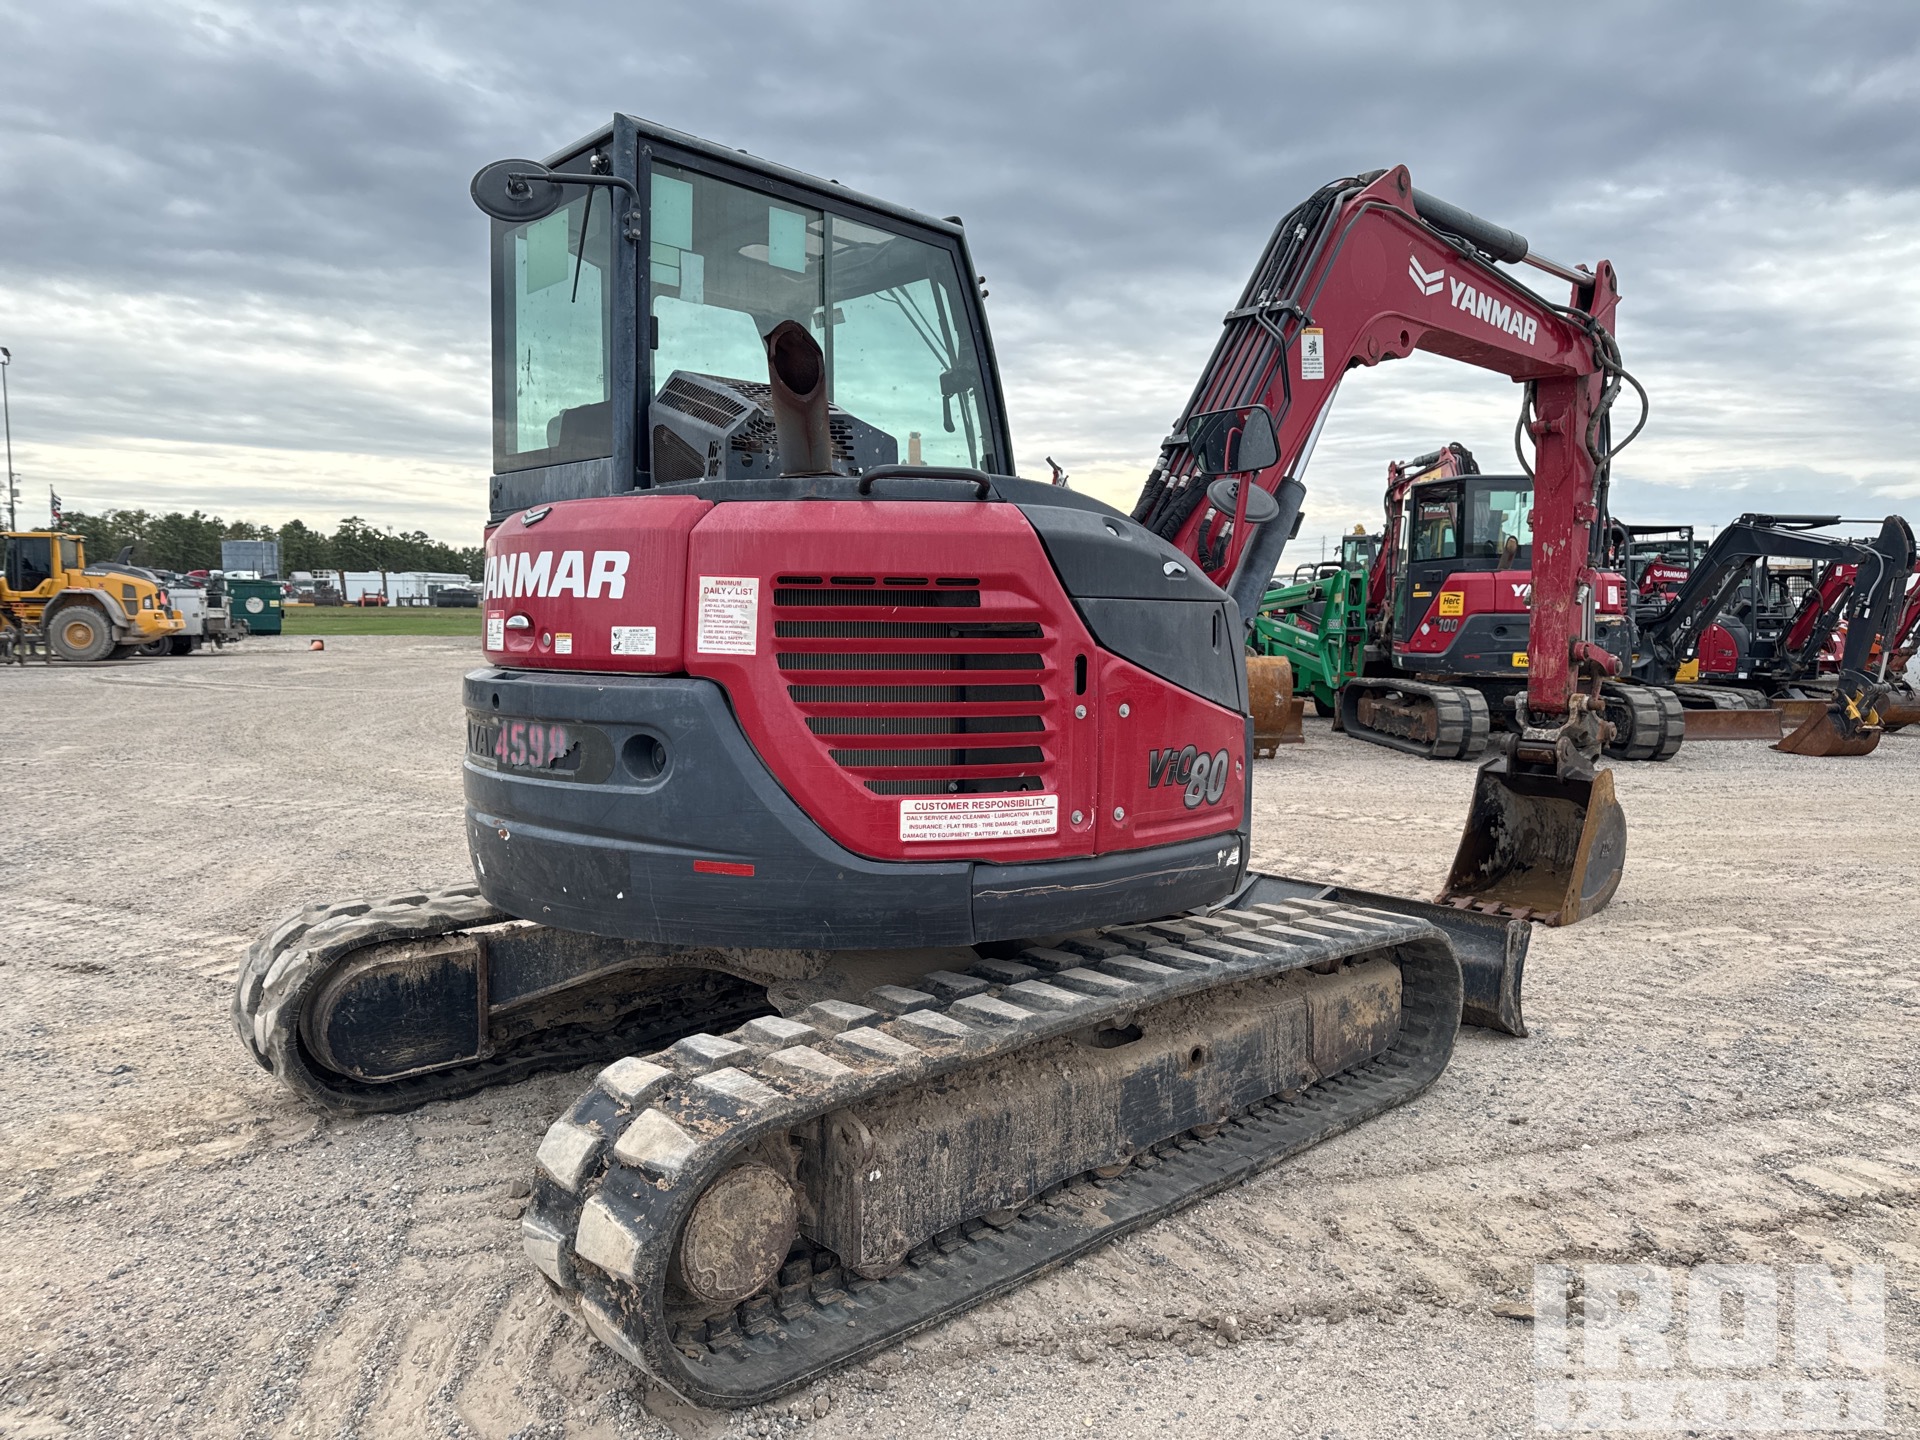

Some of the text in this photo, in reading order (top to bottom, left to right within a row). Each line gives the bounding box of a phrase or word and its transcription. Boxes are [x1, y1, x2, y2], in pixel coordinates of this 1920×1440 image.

[1450, 276, 1537, 346] YANMAR
[484, 550, 630, 601] YANMAR
[1663, 570, 1688, 579] YANMAR
[1443, 597, 1460, 605] Herc
[914, 798, 1046, 810] CUSTOMER RESPONSIBILITY
